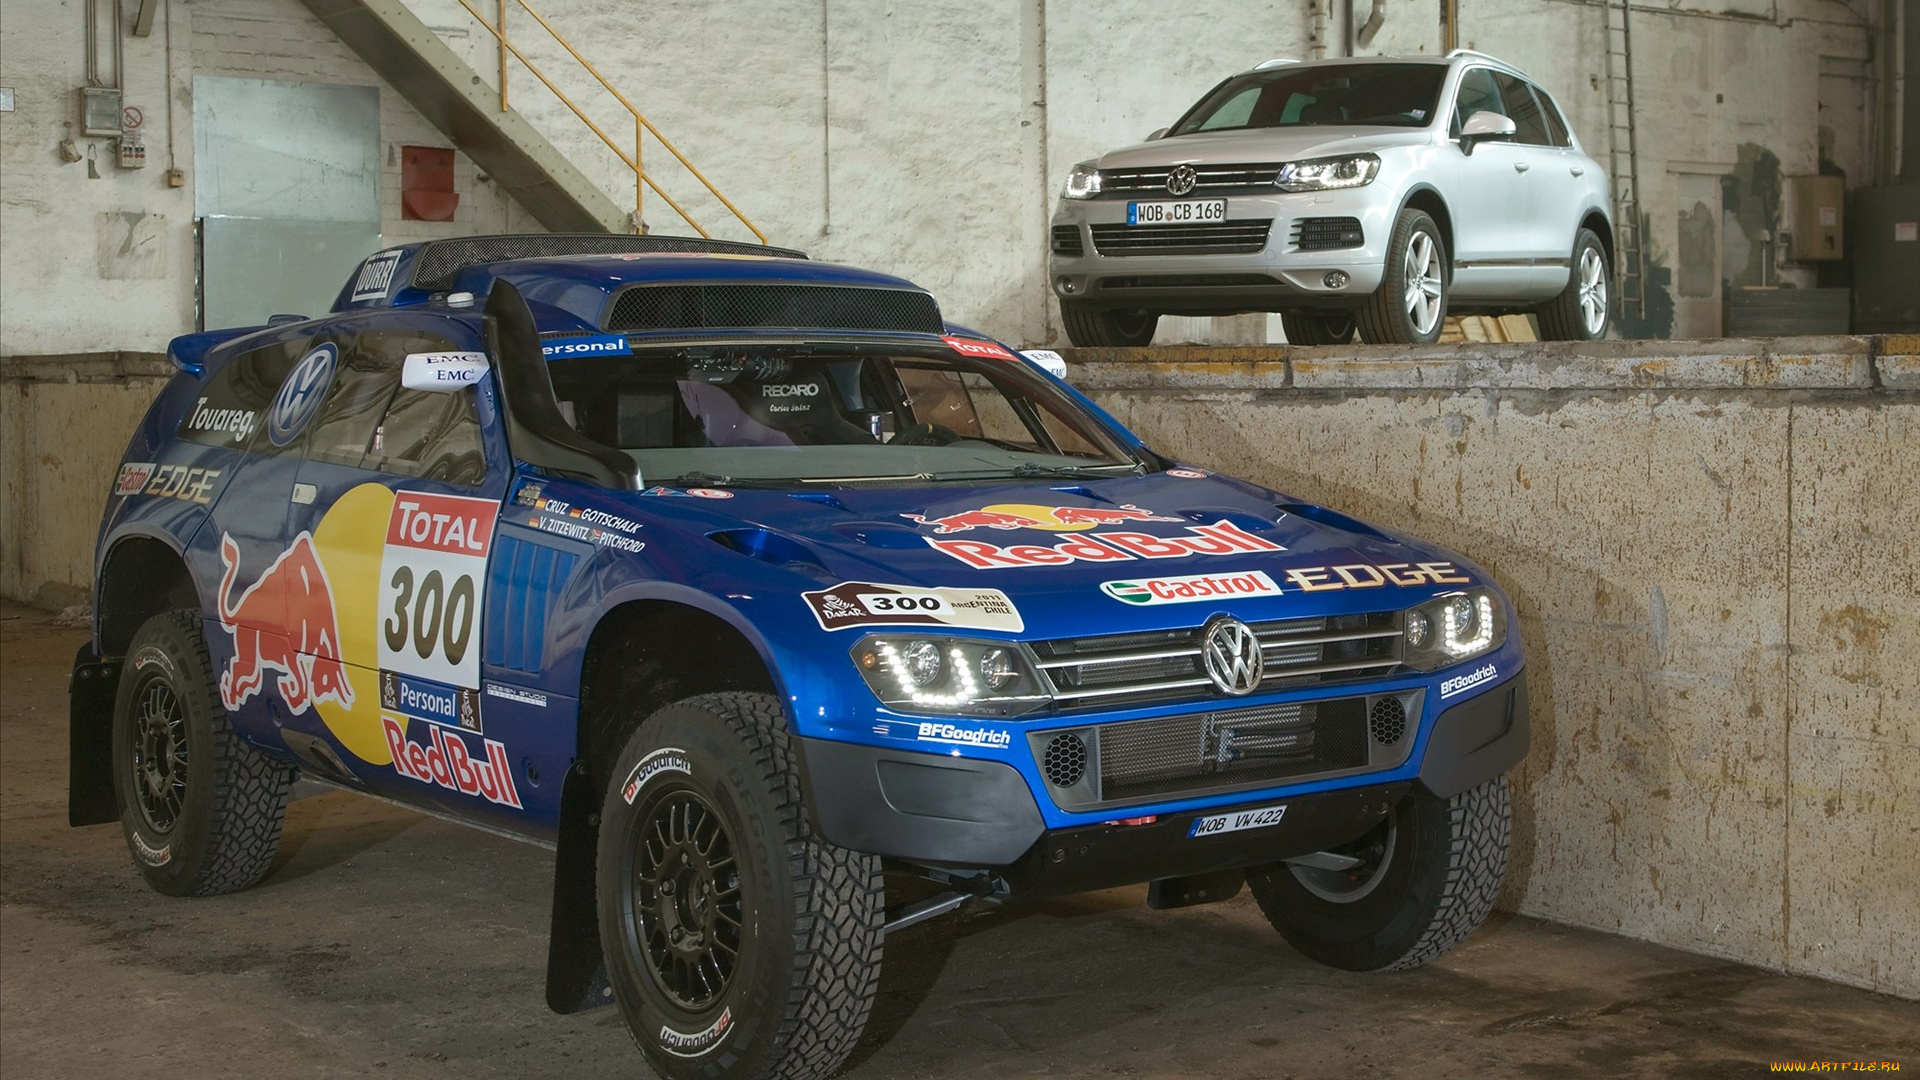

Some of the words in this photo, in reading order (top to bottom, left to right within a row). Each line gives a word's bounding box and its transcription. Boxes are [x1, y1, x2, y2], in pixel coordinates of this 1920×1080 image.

[1137, 204, 1164, 222] WOB
[1173, 203, 1192, 220] CB
[1195, 202, 1223, 220] 168
[541, 338, 624, 355] ersonal
[762, 383, 820, 398] RECARO
[146, 464, 221, 505] EDGE
[399, 501, 483, 550] TOTAL
[544, 499, 569, 515] CRUZ
[581, 508, 643, 534] GOTTSCHALK
[539, 516, 547, 529] V.
[547, 518, 590, 541] ZITZEWITZ
[599, 532, 646, 553] PITCHFORD
[928, 534, 1136, 568] Red
[1095, 520, 1284, 558] Bull
[1149, 573, 1272, 599] Castrol
[1286, 562, 1470, 593] EDGE
[384, 565, 475, 666] 300
[823, 609, 866, 619] DAKAR
[872, 597, 940, 611] 300
[951, 600, 1008, 609] ARGENTINA
[984, 606, 1012, 615] CHILE
[1440, 663, 1497, 695] BFGoodrich
[400, 681, 456, 717] Personal
[917, 722, 1011, 744] BFGoodrich
[382, 716, 457, 789] Red
[443, 733, 521, 808] Bull
[1197, 817, 1227, 834] WOB
[1234, 812, 1255, 828] VW
[1254, 809, 1283, 825] 422
